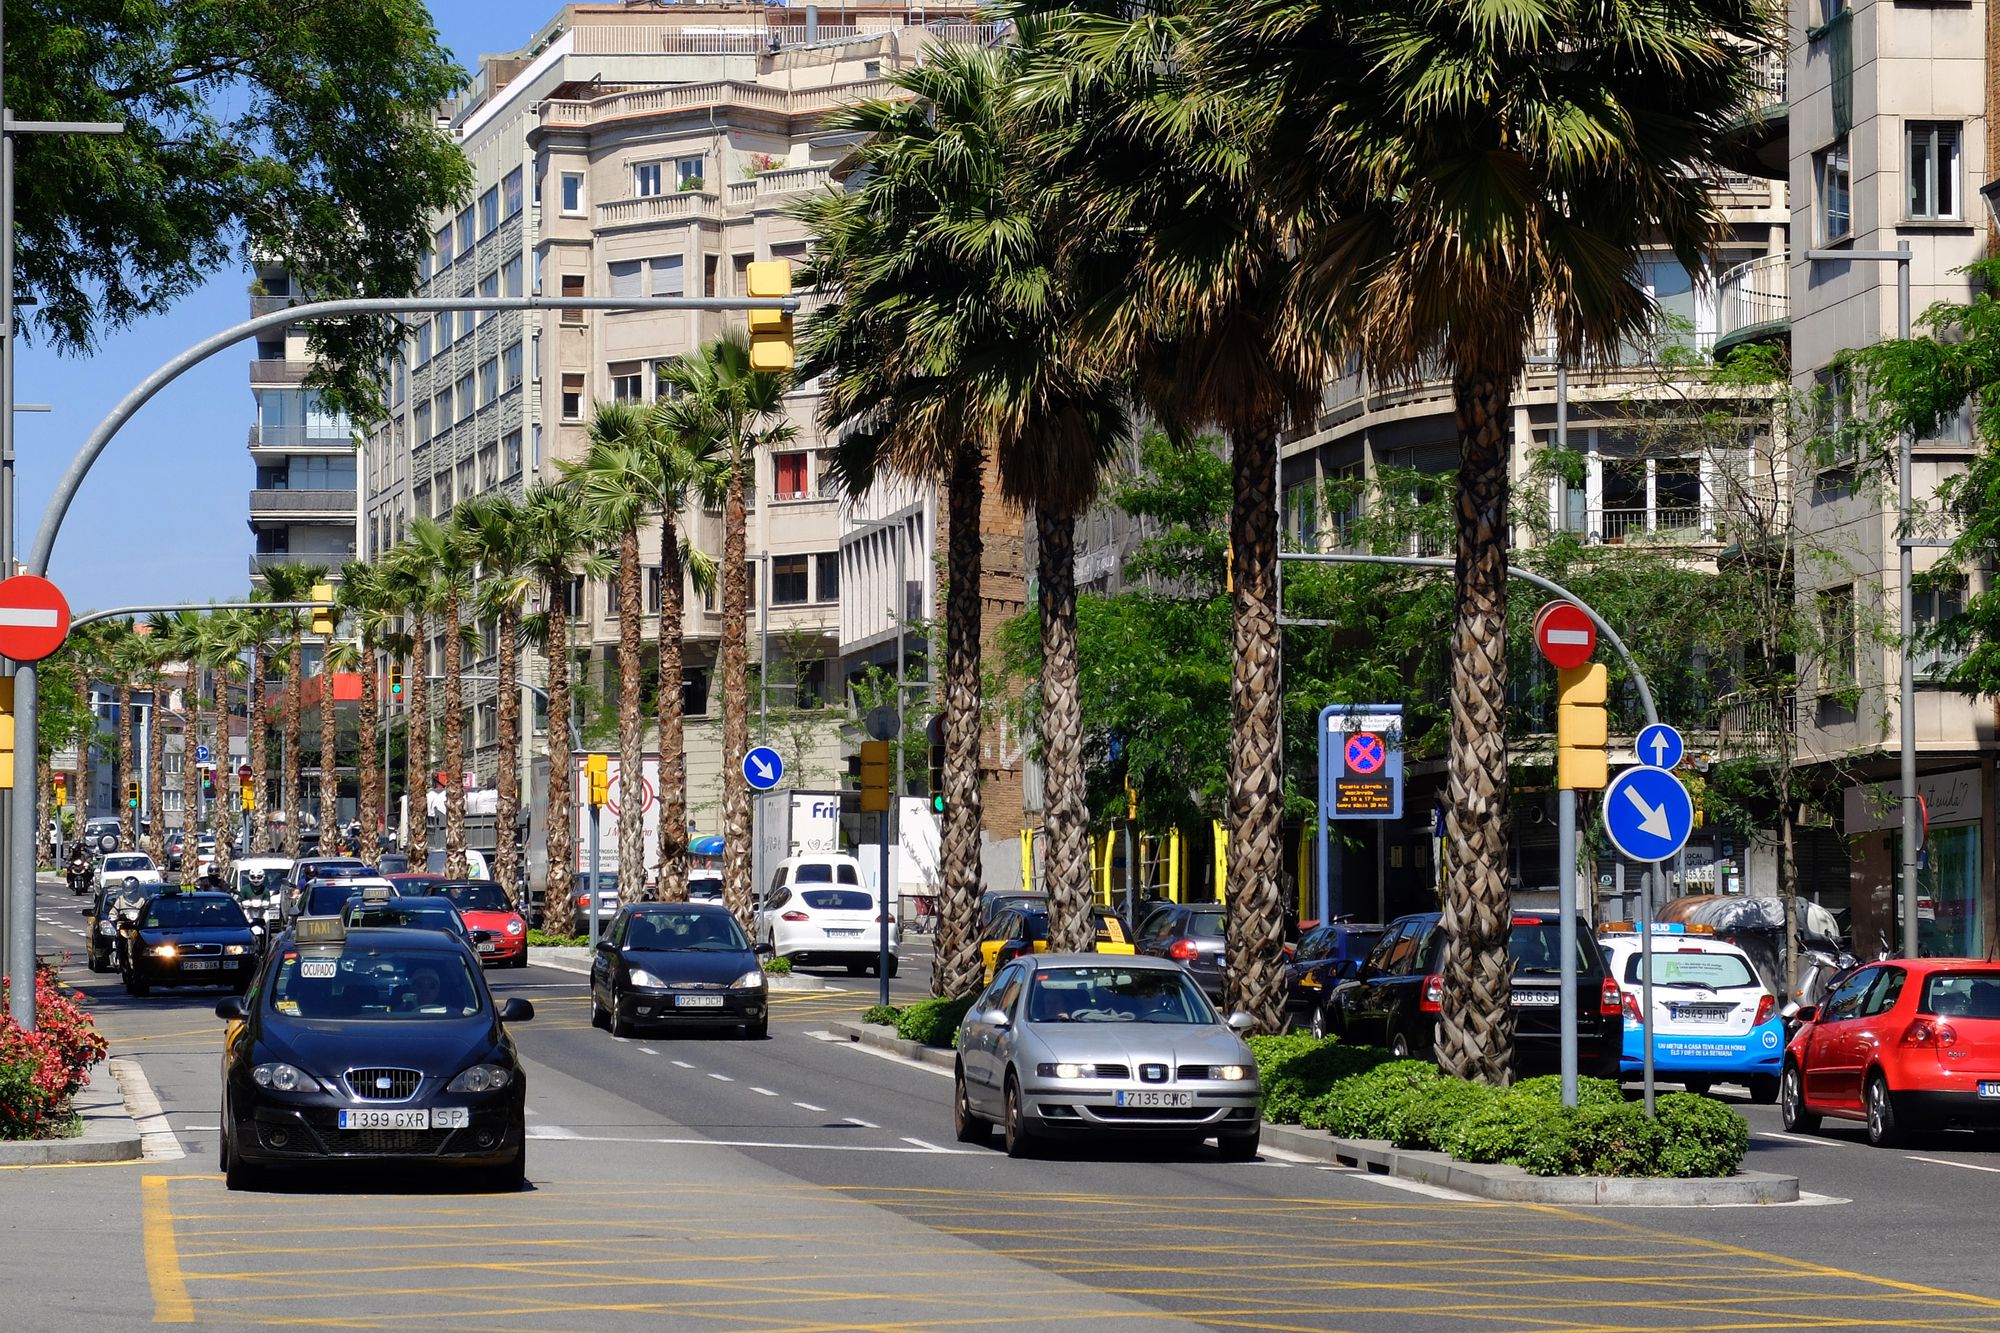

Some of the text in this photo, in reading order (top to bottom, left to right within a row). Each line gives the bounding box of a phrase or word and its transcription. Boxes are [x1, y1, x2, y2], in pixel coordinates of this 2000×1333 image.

[309, 921, 330, 934] TAXI
[303, 963, 335, 976] OCUPADO
[1678, 1008, 1726, 1019] 8945 HPN
[1127, 1093, 1187, 1106] 7135 CWC
[351, 1112, 424, 1127] 1399 GXR
[437, 1110, 463, 1125] SP
